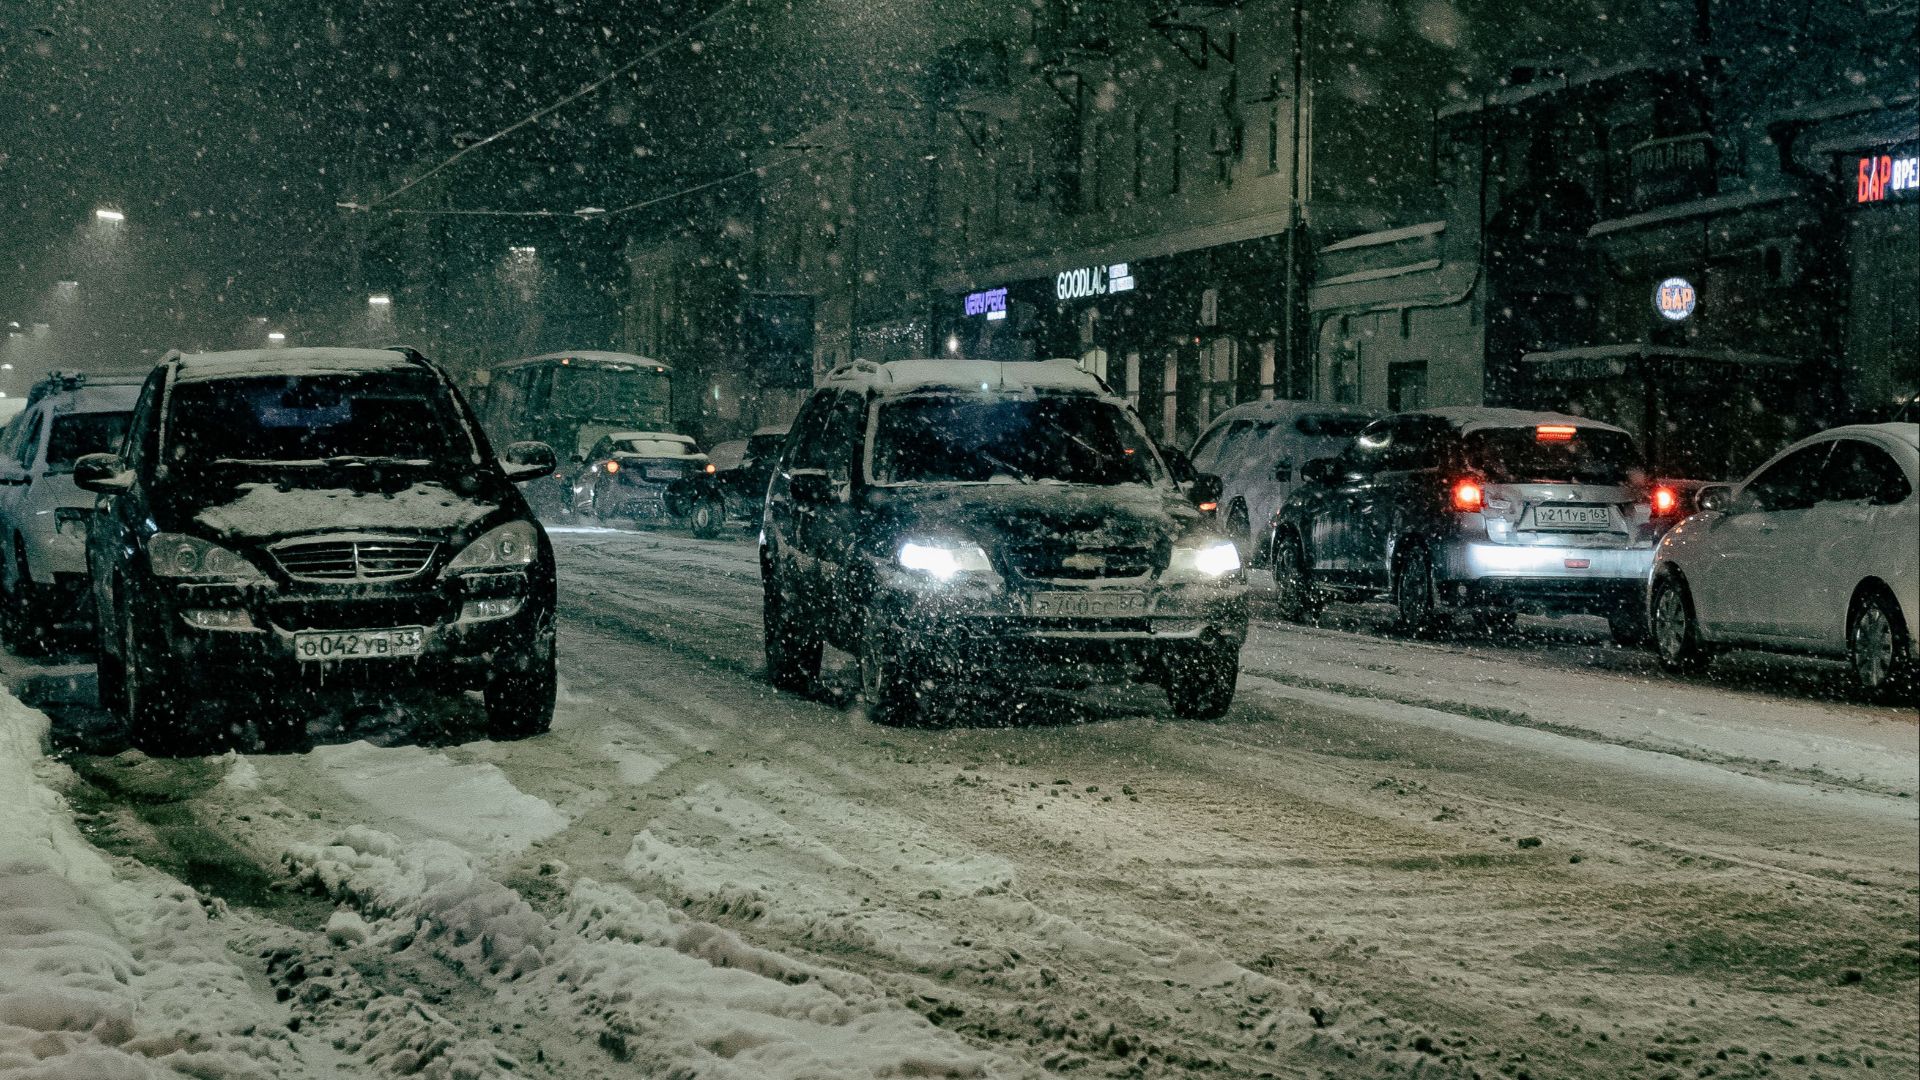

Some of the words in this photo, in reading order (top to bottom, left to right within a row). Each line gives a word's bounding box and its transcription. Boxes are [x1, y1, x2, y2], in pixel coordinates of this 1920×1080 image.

[1858, 155, 1891, 203] БАР
[1057, 265, 1106, 299] GOODLAC
[1661, 287, 1692, 310] БАР
